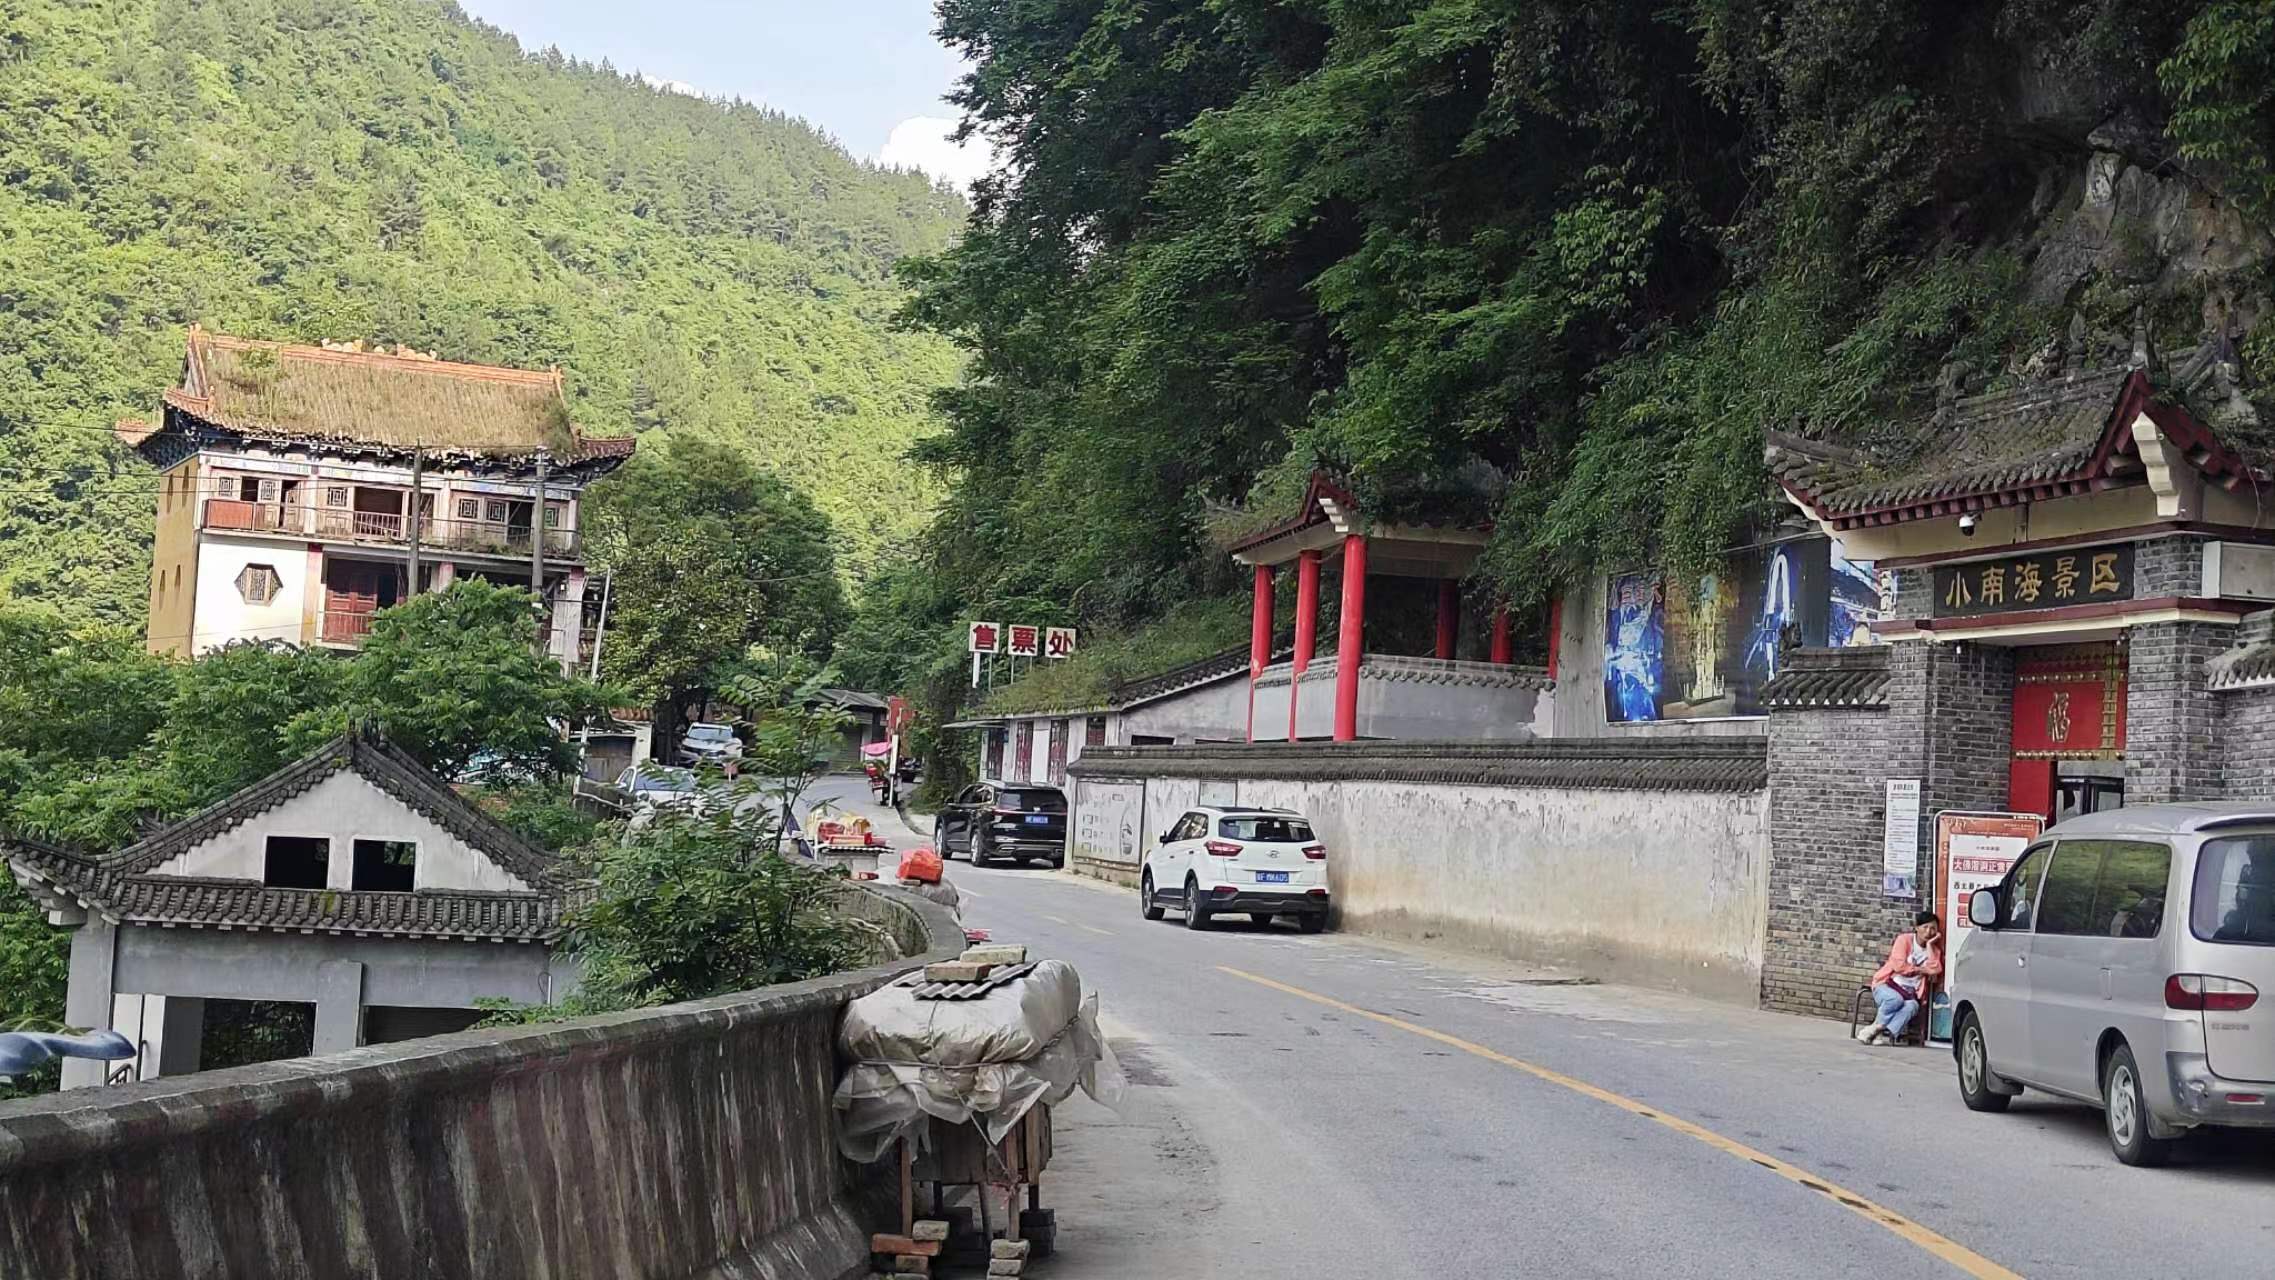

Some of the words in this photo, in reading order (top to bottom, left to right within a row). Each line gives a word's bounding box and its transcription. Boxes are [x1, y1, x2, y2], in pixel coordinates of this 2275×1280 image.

[1945, 553, 2121, 609] 小南海景区
[972, 624, 1074, 656] 售票处
